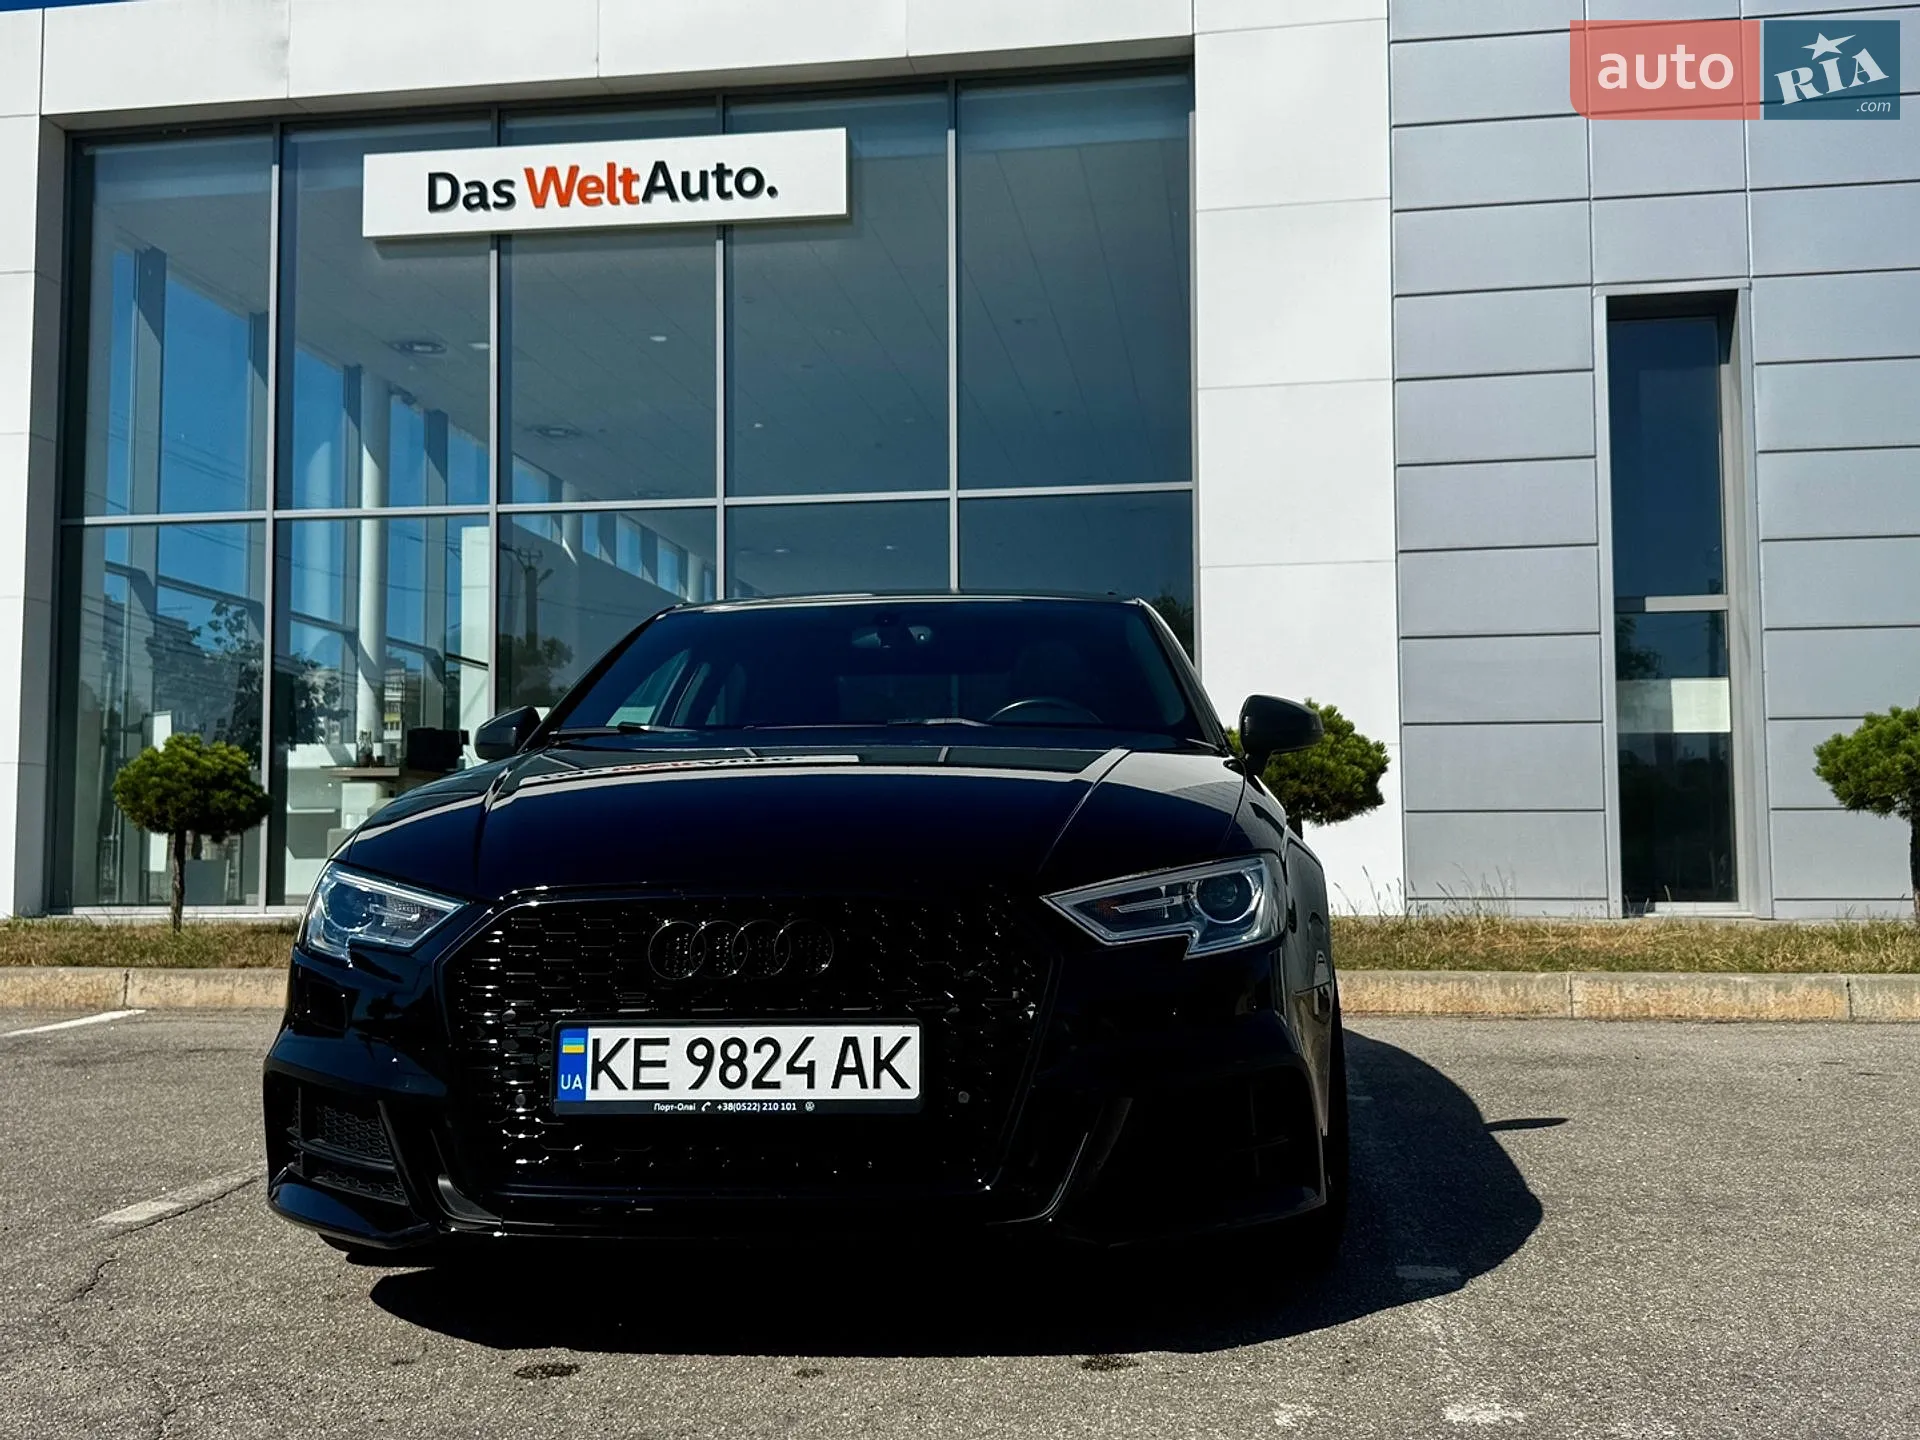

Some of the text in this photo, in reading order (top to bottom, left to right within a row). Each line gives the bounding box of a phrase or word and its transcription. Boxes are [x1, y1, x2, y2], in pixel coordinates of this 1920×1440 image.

[427, 171, 515, 212] Das
[590, 1035, 912, 1091] KE 9824 AK
[560, 1074, 583, 1091] UA
[762, 1103, 779, 1111] 210
[780, 1103, 797, 1111] 101
